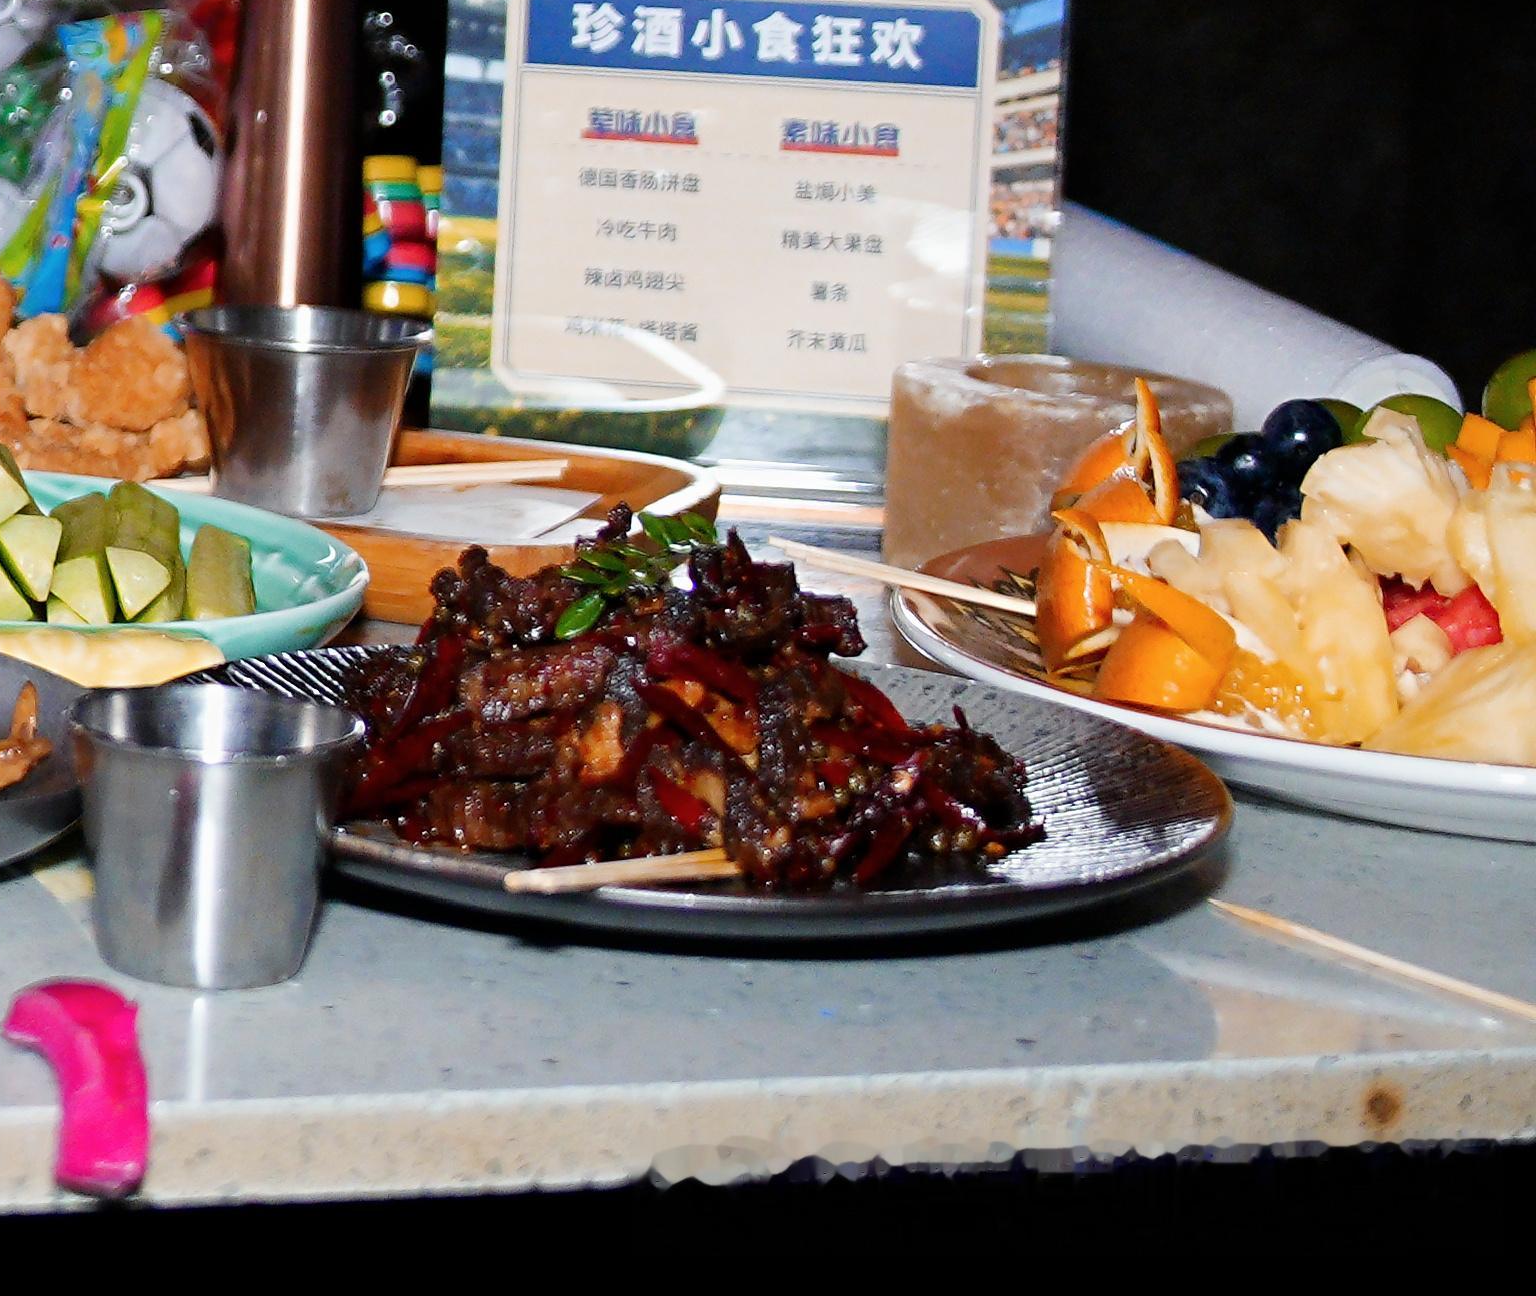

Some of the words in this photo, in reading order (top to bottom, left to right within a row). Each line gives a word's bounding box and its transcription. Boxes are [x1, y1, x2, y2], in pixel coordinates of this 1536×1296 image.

[570, 1, 927, 71] 珍酒小食狂欢
[596, 218, 677, 242] 冷吃牛肉
[781, 229, 885, 255] 精美大果盘
[810, 280, 849, 302] 薯条
[787, 328, 867, 354] 芥末黄瓜
